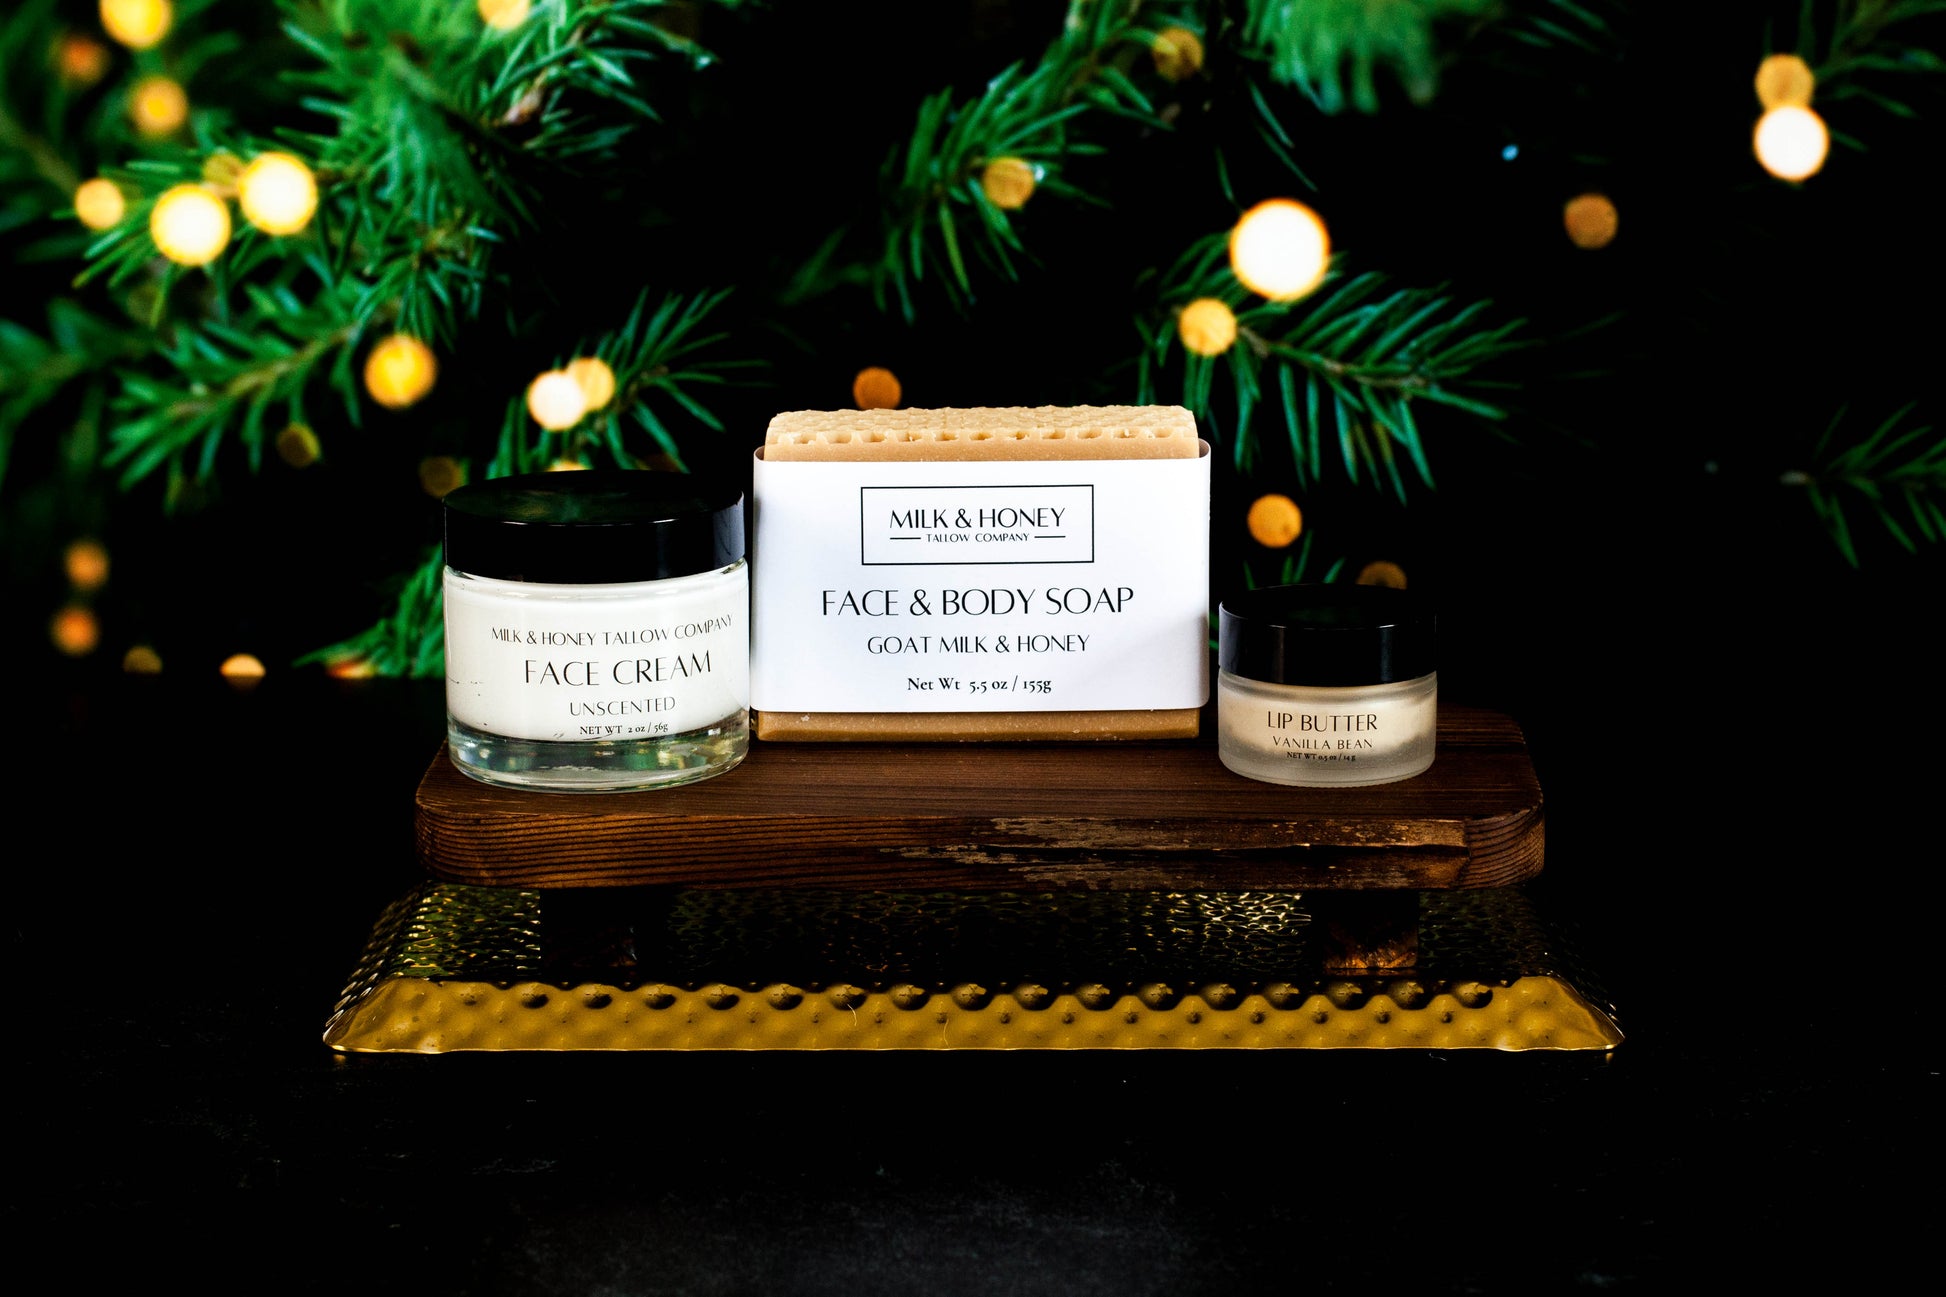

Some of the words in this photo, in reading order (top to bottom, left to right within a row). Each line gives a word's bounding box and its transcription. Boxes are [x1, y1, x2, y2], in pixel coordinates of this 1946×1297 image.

[889, 508, 948, 530] MILK
[953, 507, 973, 529] &
[978, 506, 1066, 529] HONEY
[925, 532, 971, 544] TALLOW
[974, 531, 1030, 543] COMPANY
[821, 588, 900, 616] FACE
[908, 588, 932, 616] &
[942, 587, 1036, 615] BODY
[1045, 586, 1135, 615] SOAP
[491, 627, 522, 643] MILK
[526, 631, 537, 645] &
[542, 632, 597, 646] HONEY
[602, 628, 670, 645] TALLOW
[674, 613, 733, 640] COMPANY
[867, 635, 932, 655] GOAT
[938, 635, 989, 654] MILK
[994, 634, 1011, 653] &
[1017, 633, 1090, 653] HONEY
[525, 659, 600, 687] FACE
[612, 649, 711, 686] CREAM
[907, 676, 935, 692] Net
[938, 676, 961, 692] Wt
[968, 680, 988, 694] 5.5
[991, 680, 1009, 692] oz
[1011, 674, 1019, 694] /
[1022, 680, 1053, 695] 155g
[569, 696, 677, 717] UNSCENTED
[579, 724, 603, 736] NET
[604, 724, 623, 735] WT
[648, 722, 652, 734] /
[654, 722, 669, 734] 56g
[1267, 711, 1293, 729] LIP
[1301, 714, 1378, 733] BUTTER
[1272, 735, 1331, 750] VANILLA
[1337, 738, 1373, 750] BEAN
